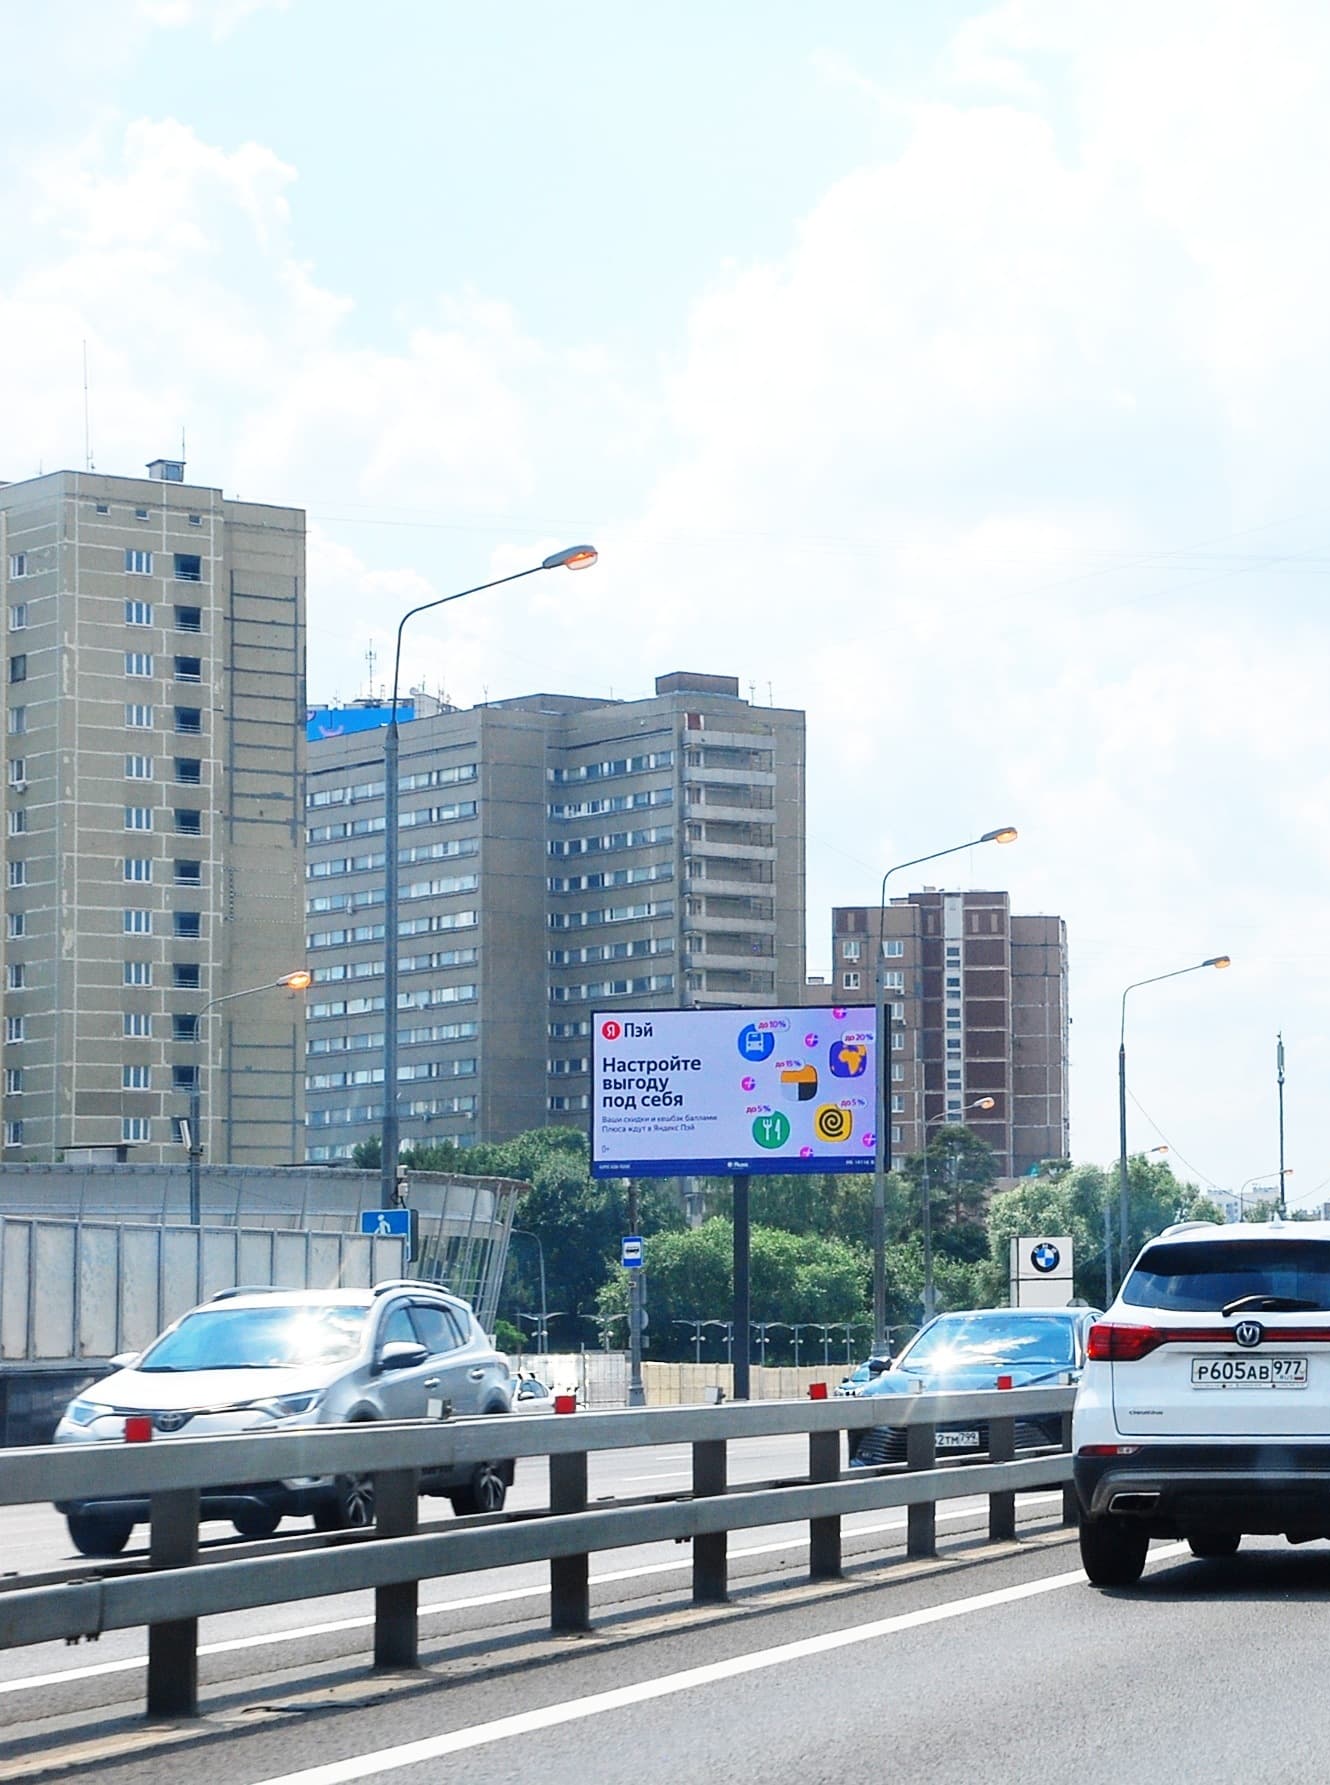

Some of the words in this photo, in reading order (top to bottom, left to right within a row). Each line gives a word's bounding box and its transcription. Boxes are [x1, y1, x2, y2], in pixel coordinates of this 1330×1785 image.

[624, 1022, 653, 1038] Пэй
[603, 1055, 702, 1075] Настройте
[603, 1077, 669, 1093] выгоду
[603, 1095, 637, 1110] под
[641, 1091, 683, 1107] себя
[1273, 1360, 1302, 1375] 977
[935, 1433, 959, 1446] 2ТМ
